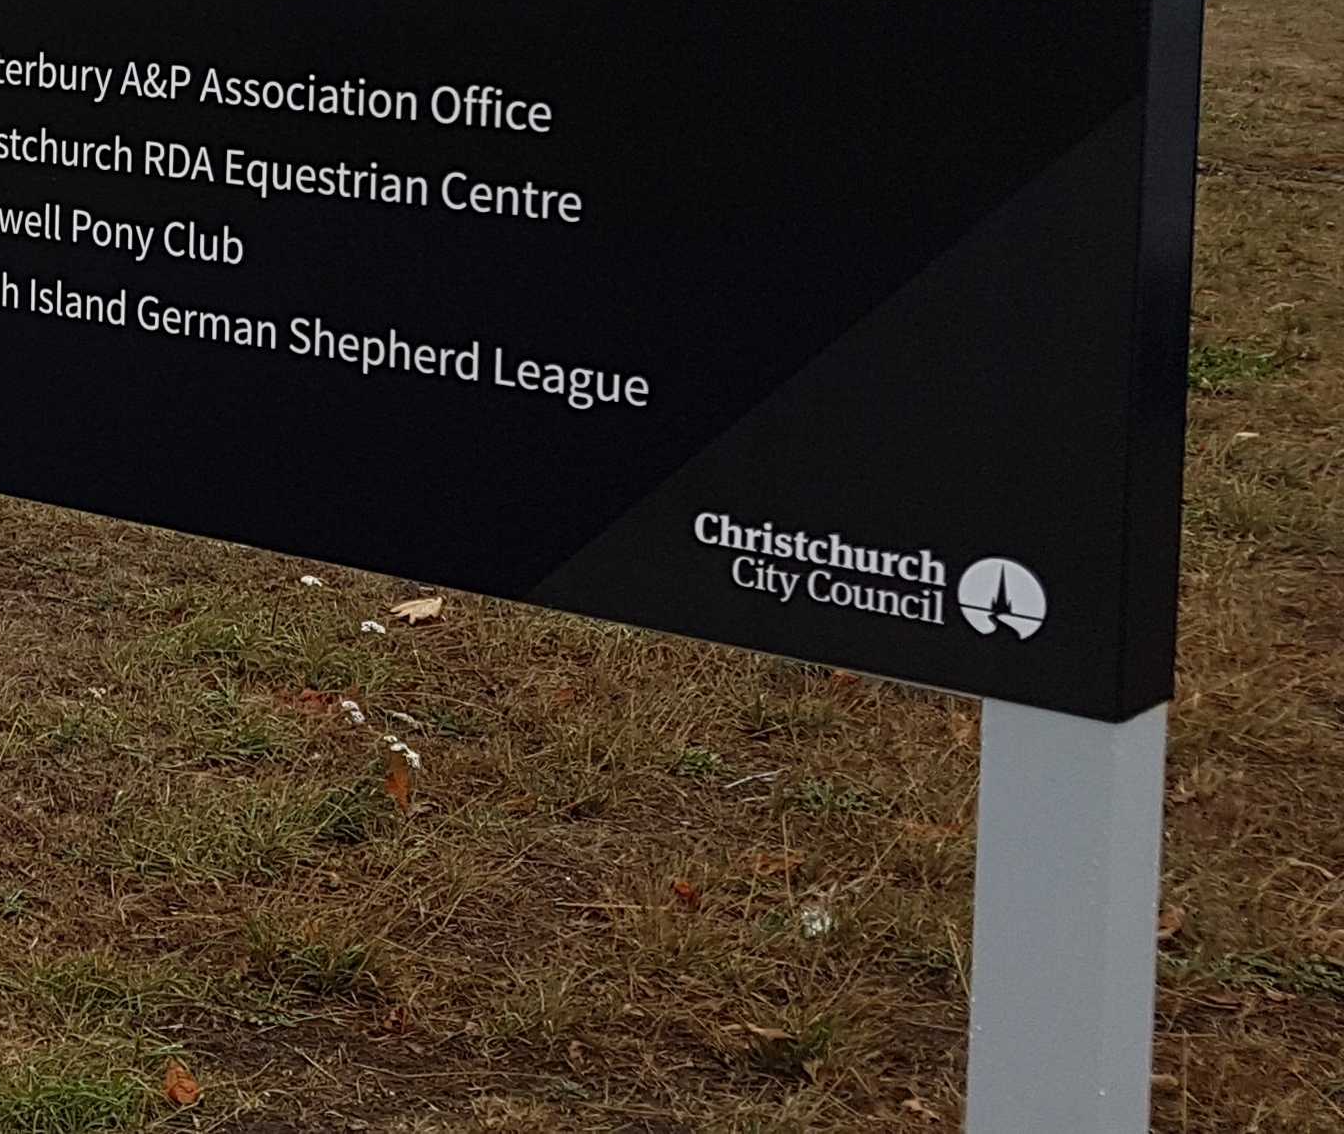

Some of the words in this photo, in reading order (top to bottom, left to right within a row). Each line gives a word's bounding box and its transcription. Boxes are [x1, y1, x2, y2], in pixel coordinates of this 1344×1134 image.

[120, 61, 191, 100] A&P
[199, 67, 417, 121] Association
[431, 85, 552, 133] Office
[144, 140, 215, 182] RDA
[225, 149, 428, 206] Equestrian
[441, 171, 582, 223] Centre
[72, 209, 155, 262] Pony
[163, 221, 243, 265] Club
[30, 278, 126, 326] Island
[137, 295, 276, 350] German
[289, 317, 479, 381] Shepherd
[495, 347, 649, 410] League
[694, 512, 946, 587] Christchurch
[732, 556, 800, 603] City
[807, 570, 945, 625] Council
